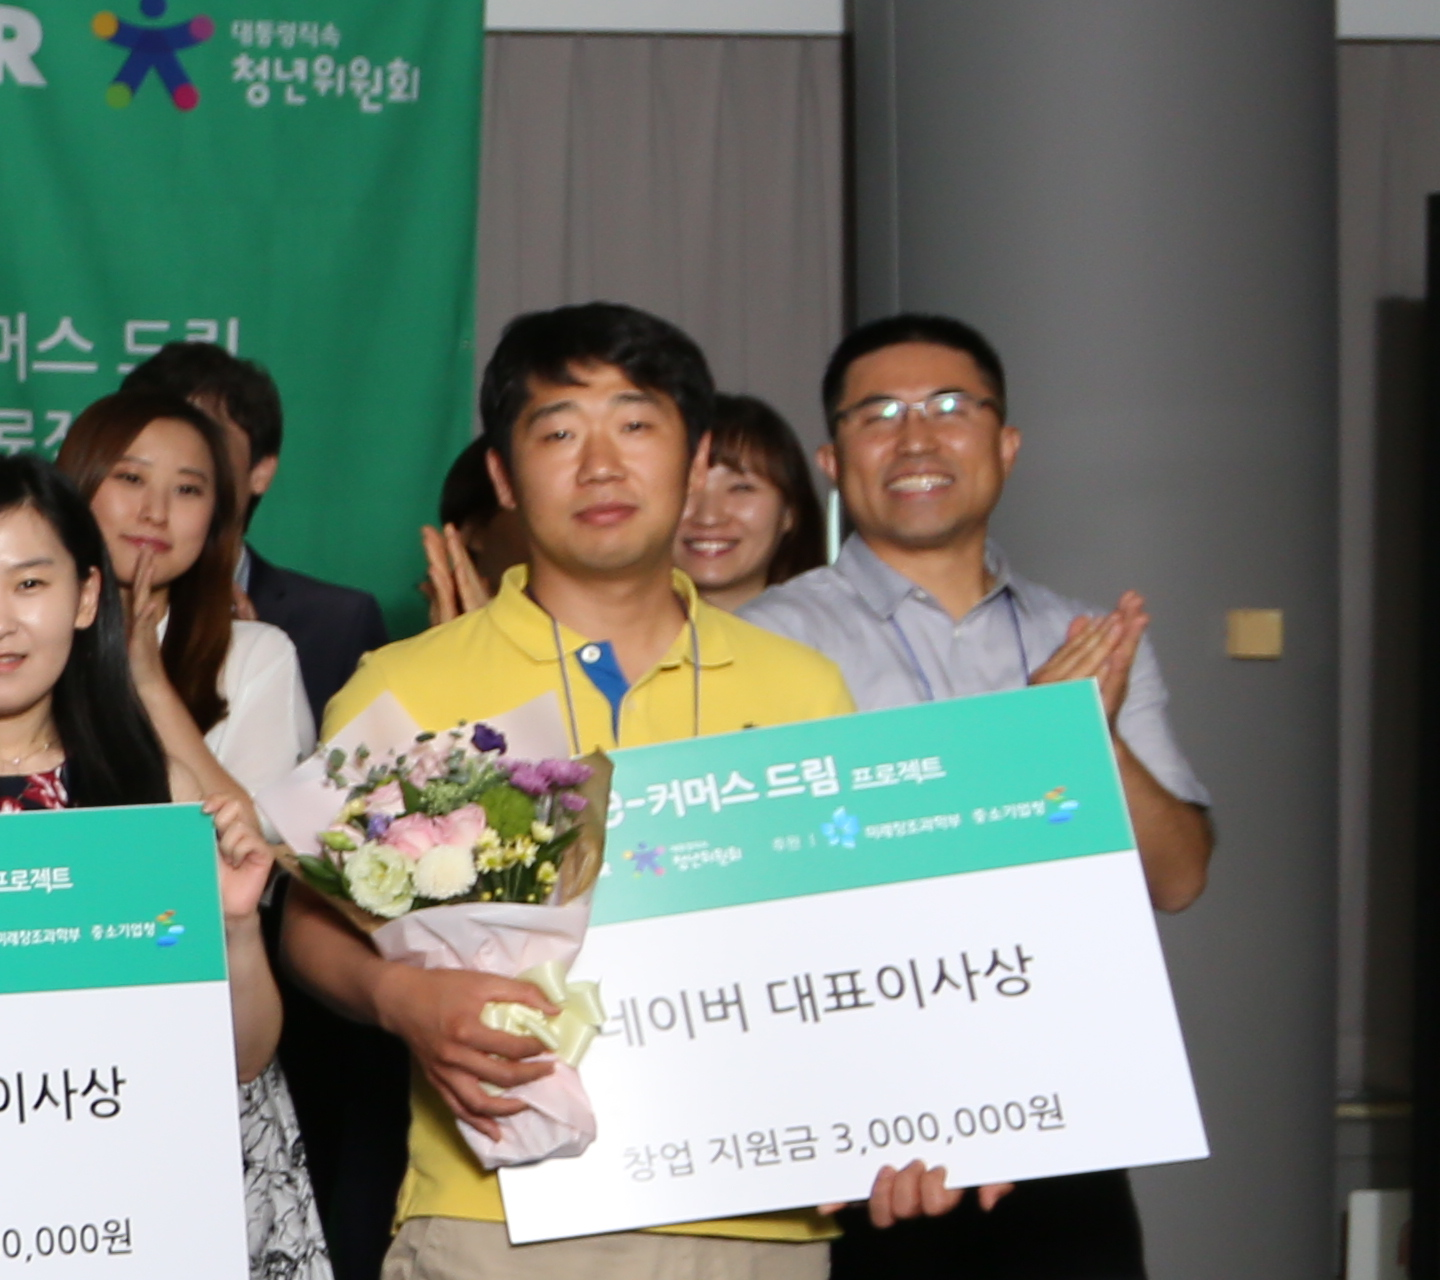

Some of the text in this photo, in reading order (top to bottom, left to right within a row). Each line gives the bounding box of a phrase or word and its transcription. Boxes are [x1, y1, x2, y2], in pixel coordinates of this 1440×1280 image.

[230, 54, 420, 113] 청년위원회
[766, 755, 840, 798] 드림
[852, 756, 947, 791] 프로젝트
[91, 922, 156, 940] 중소기업청
[601, 944, 1034, 1047] 네이버 대표이사상
[622, 1092, 1067, 1183] 창업 지원금 3,000,000원
